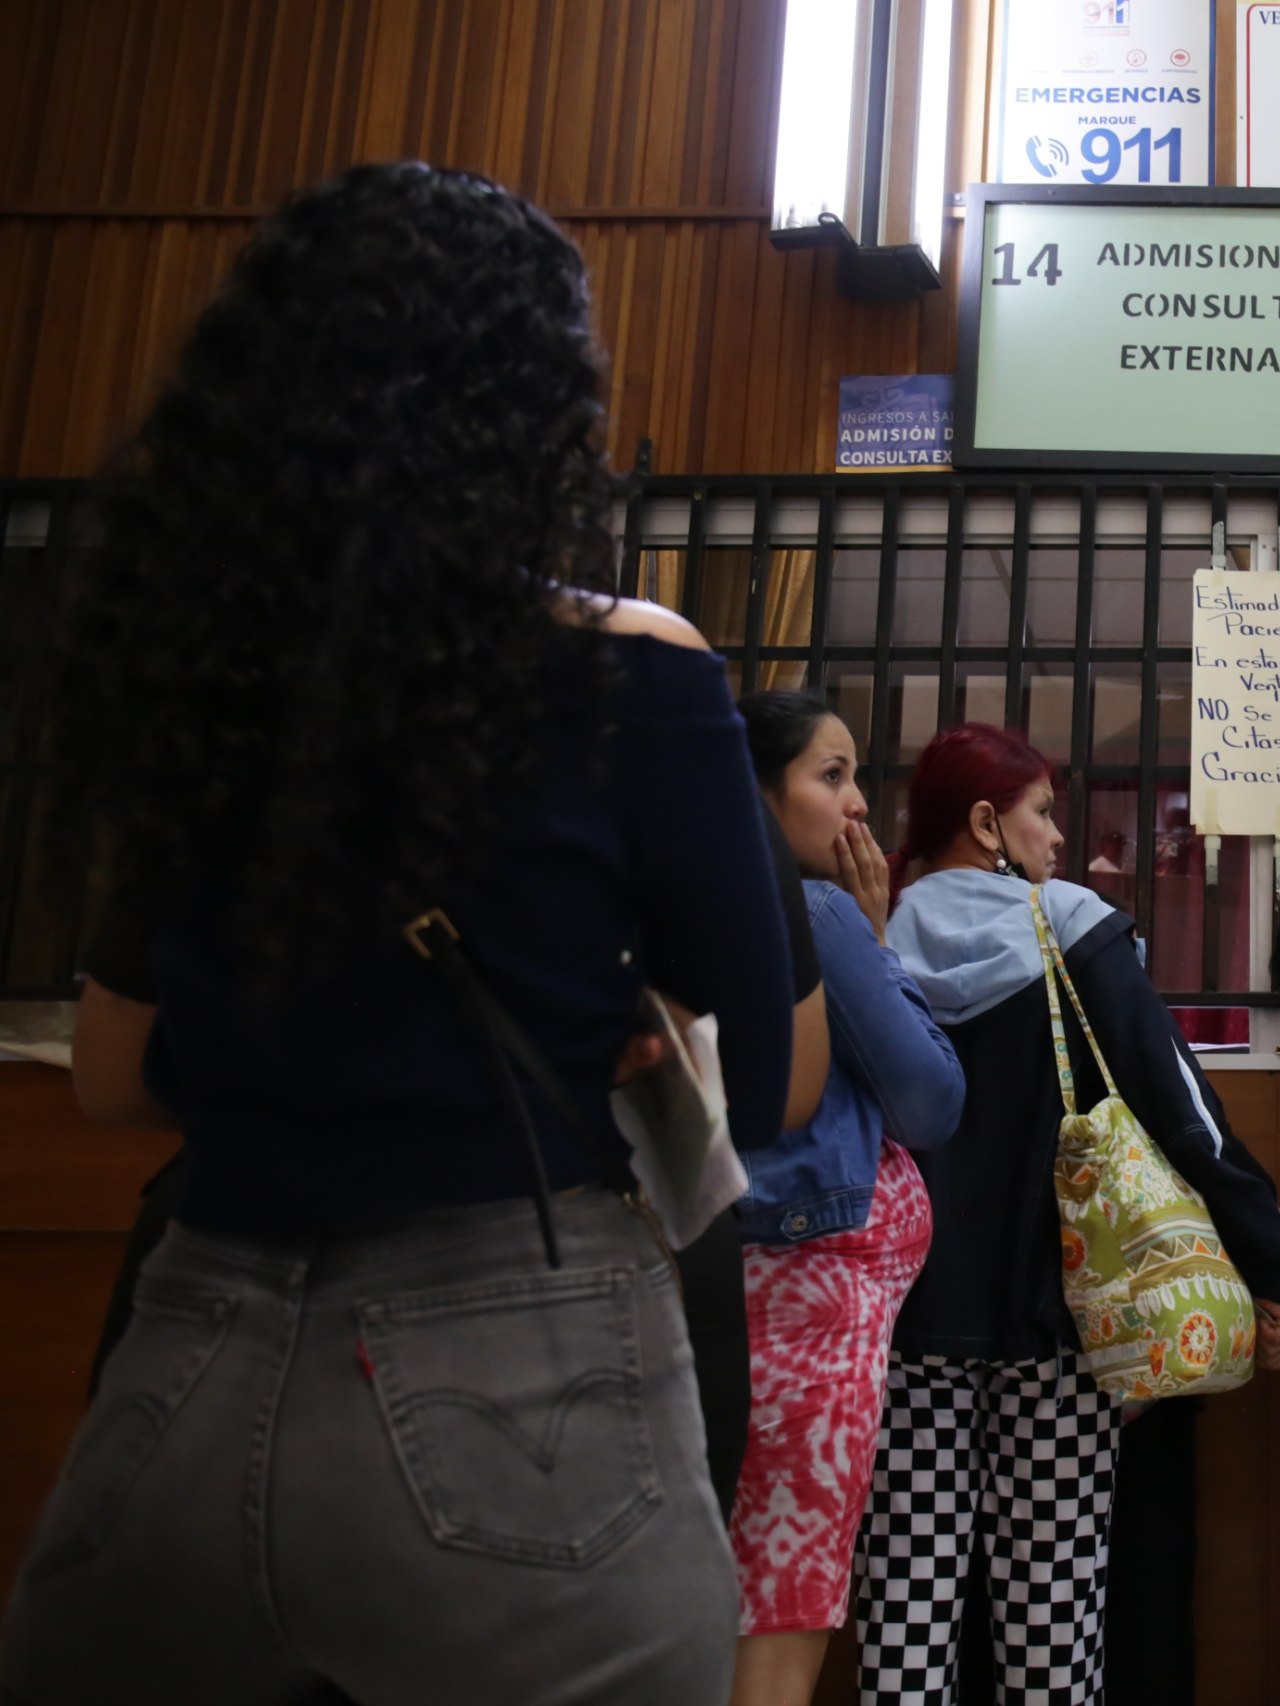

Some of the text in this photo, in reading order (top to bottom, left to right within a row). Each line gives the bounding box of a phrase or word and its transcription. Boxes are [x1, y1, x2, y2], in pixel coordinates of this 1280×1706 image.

[1015, 86, 1201, 104] EMERGENCIAS
[1078, 115, 1136, 126] MARQUE
[1080, 128, 1182, 185] 911
[991, 242, 1063, 287] 14
[1097, 242, 1280, 270] ADMISION
[1120, 344, 1280, 374] EXTERNA
[842, 411, 914, 425] INGRESOS
[919, 411, 927, 422] A
[841, 425, 936, 443] ADMISIÓN
[840, 450, 953, 465] CONSULTA EX
[1195, 646, 1227, 668] En
[1198, 698, 1229, 721] NO
